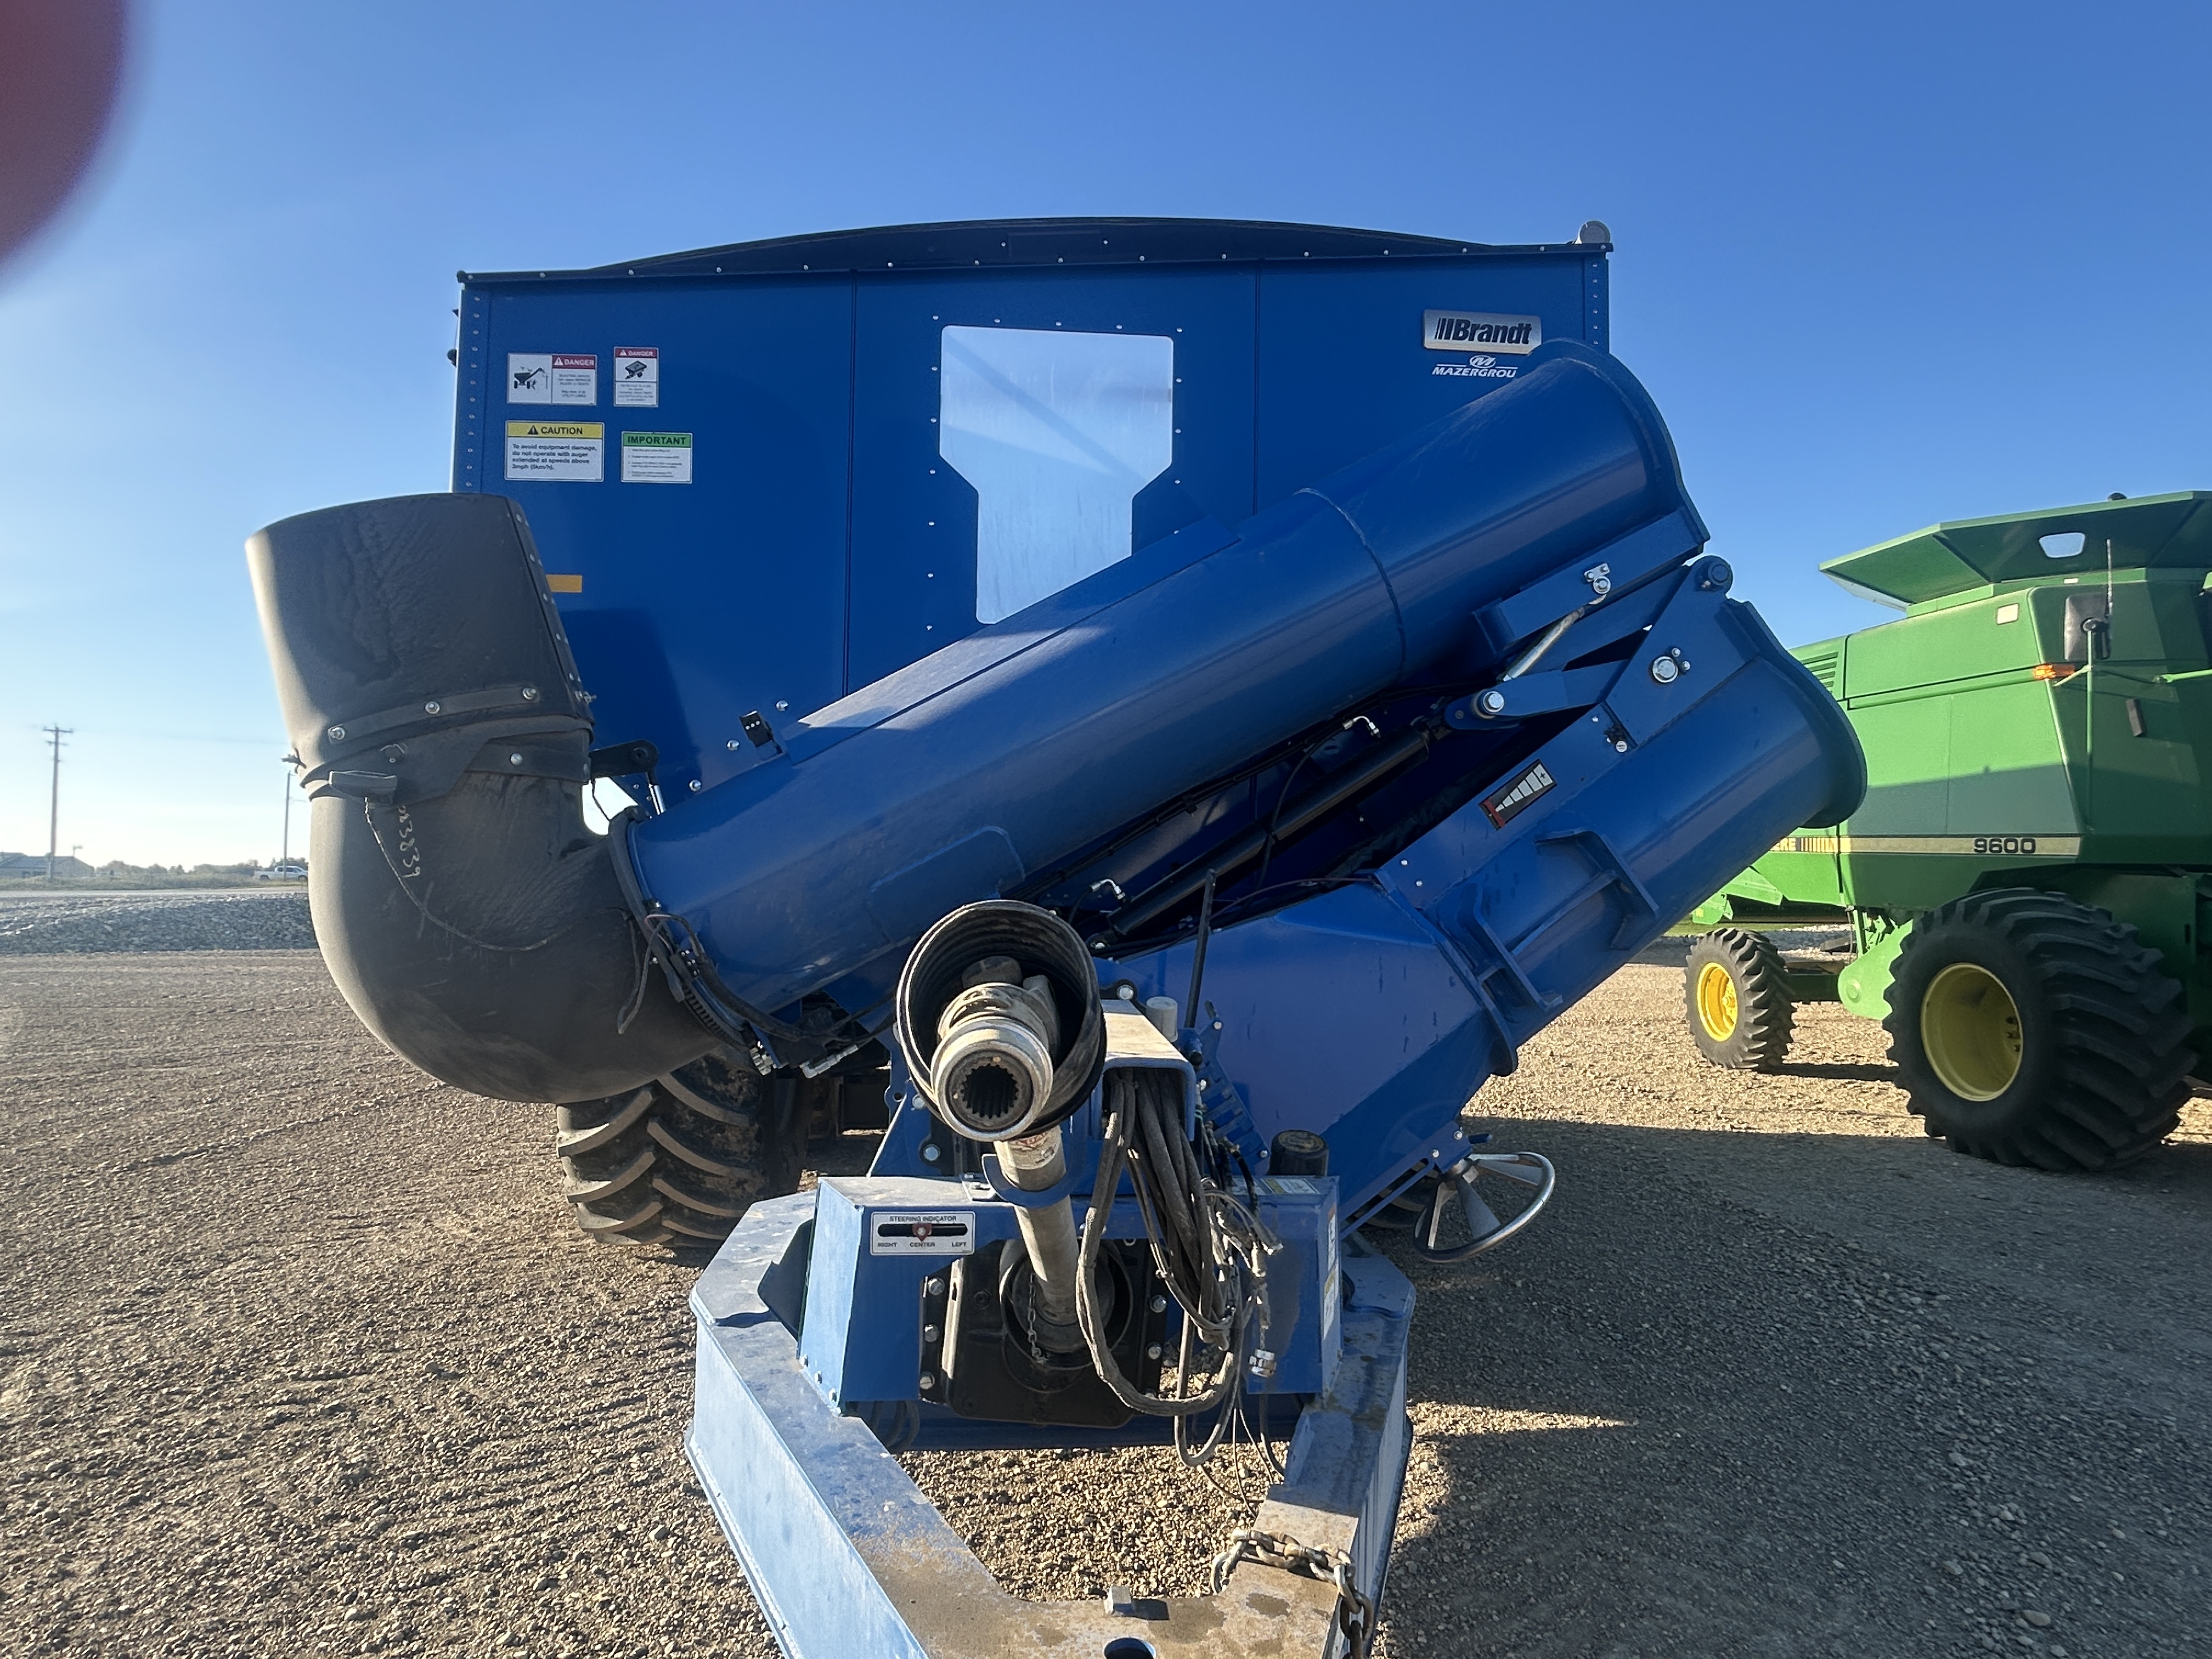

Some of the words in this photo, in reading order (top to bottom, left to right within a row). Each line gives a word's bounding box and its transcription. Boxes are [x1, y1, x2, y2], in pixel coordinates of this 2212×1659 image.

[1452, 318, 1532, 345] Brandt
[1432, 366, 1516, 378] MAZERGROU
[541, 426, 583, 435] CAUTION
[627, 436, 686, 445] IMPORTANT
[1974, 838, 2036, 854] 9600
